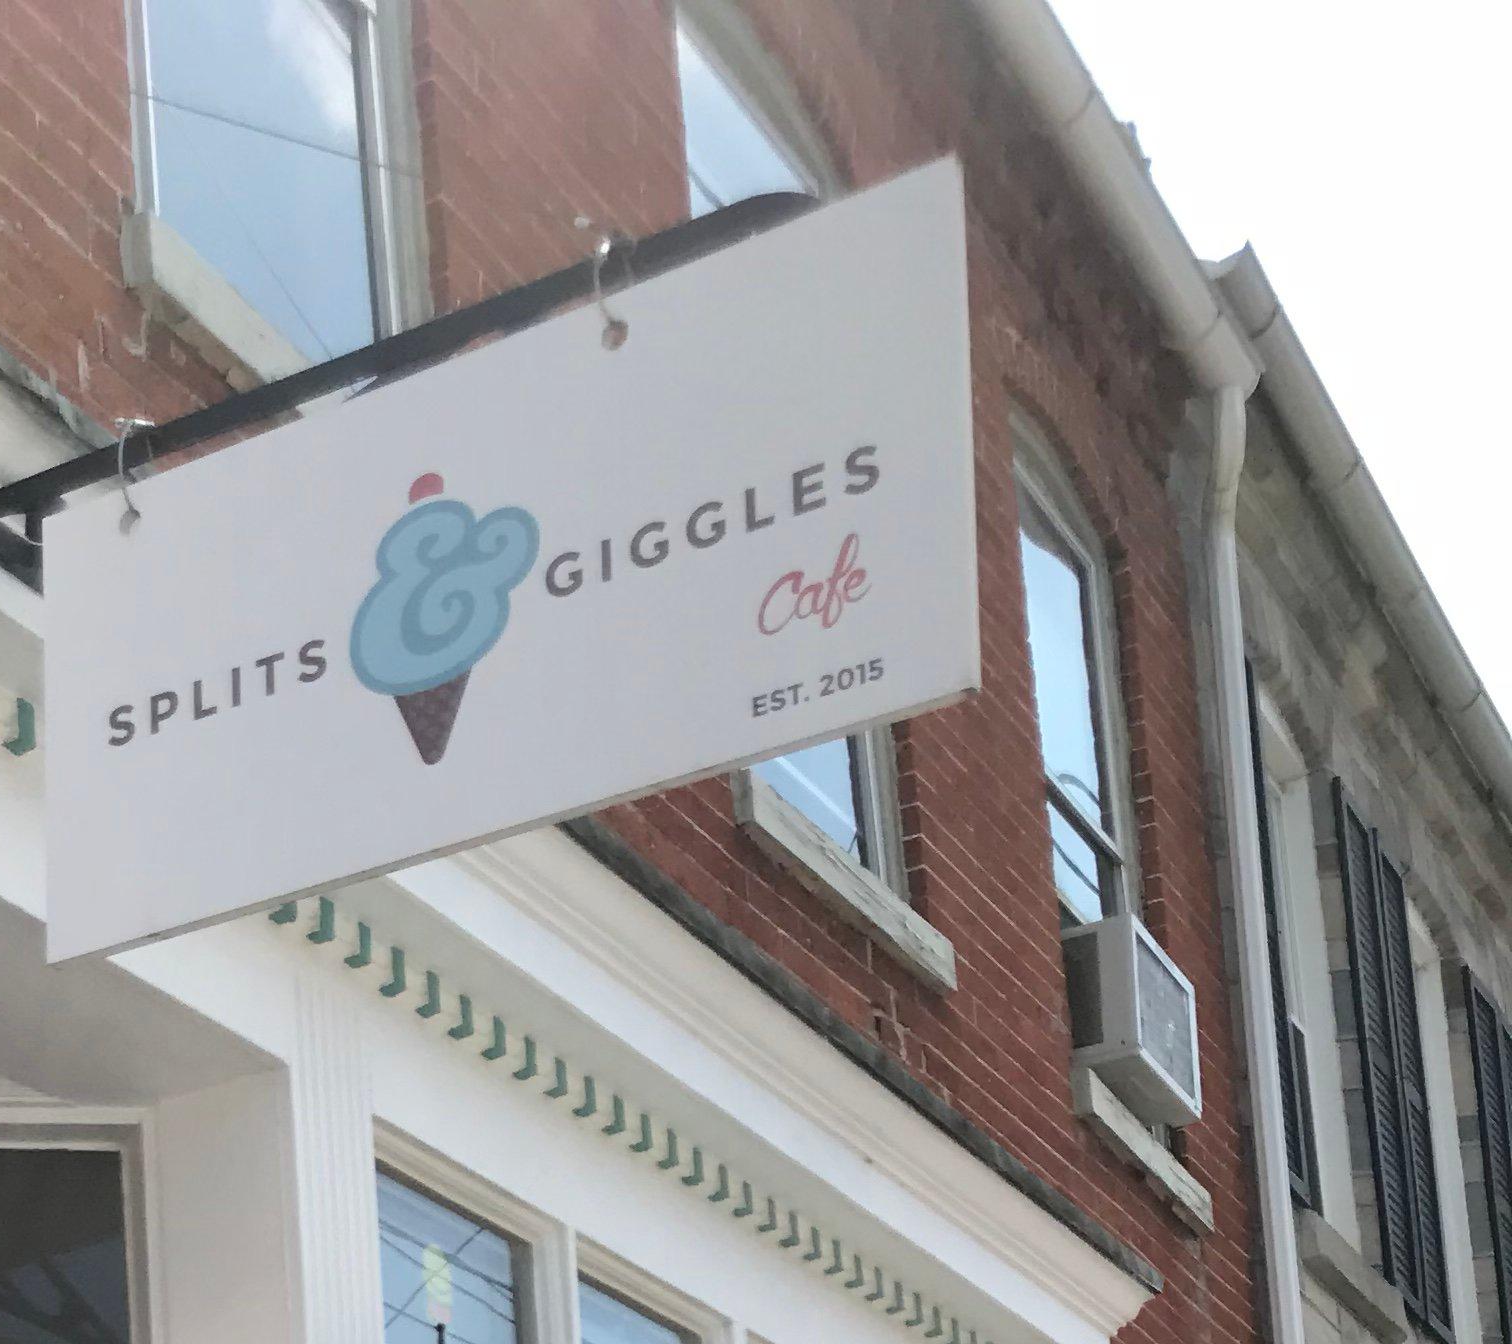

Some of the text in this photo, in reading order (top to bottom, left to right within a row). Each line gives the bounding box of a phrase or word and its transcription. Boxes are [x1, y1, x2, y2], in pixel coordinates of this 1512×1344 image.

[107, 637, 329, 748] SPLITS
[545, 444, 883, 599] GIGGLES
[758, 532, 874, 637] Cafe
[751, 656, 887, 719] EST. 2015
